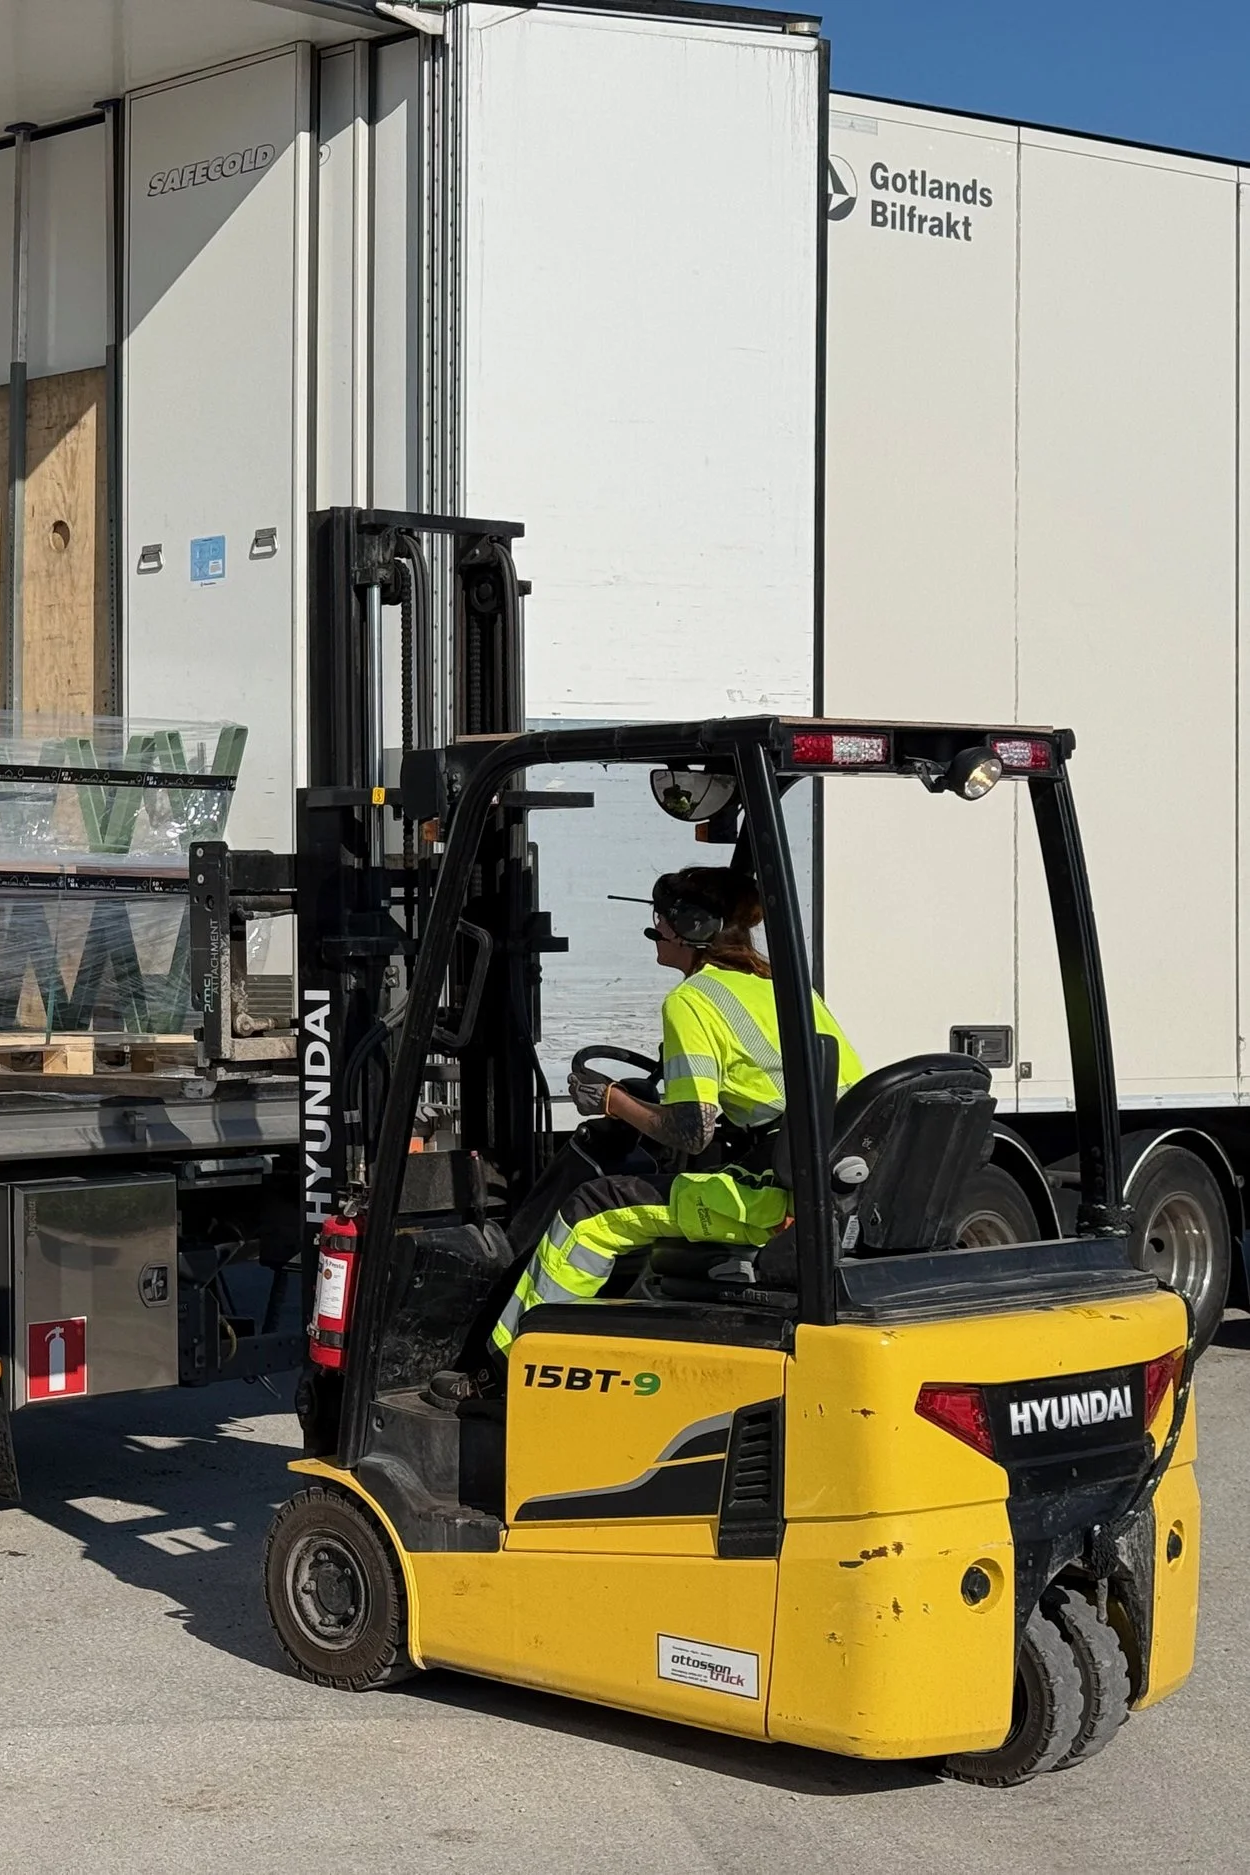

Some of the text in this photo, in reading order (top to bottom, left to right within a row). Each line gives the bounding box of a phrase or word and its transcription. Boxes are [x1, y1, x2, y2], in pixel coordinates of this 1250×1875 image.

[147, 143, 275, 197] SAFECOLD
[870, 161, 993, 208] Gotlands
[870, 199, 972, 242] Bilfrakt
[210, 918, 220, 995] ATTACHMENT
[304, 989, 332, 1223] HYUNDAI
[524, 1364, 661, 1397] 15BT-9
[1009, 1384, 1134, 1436] HYUNDAI
[671, 1654, 732, 1675] ottosson
[710, 1669, 746, 1687] truck
